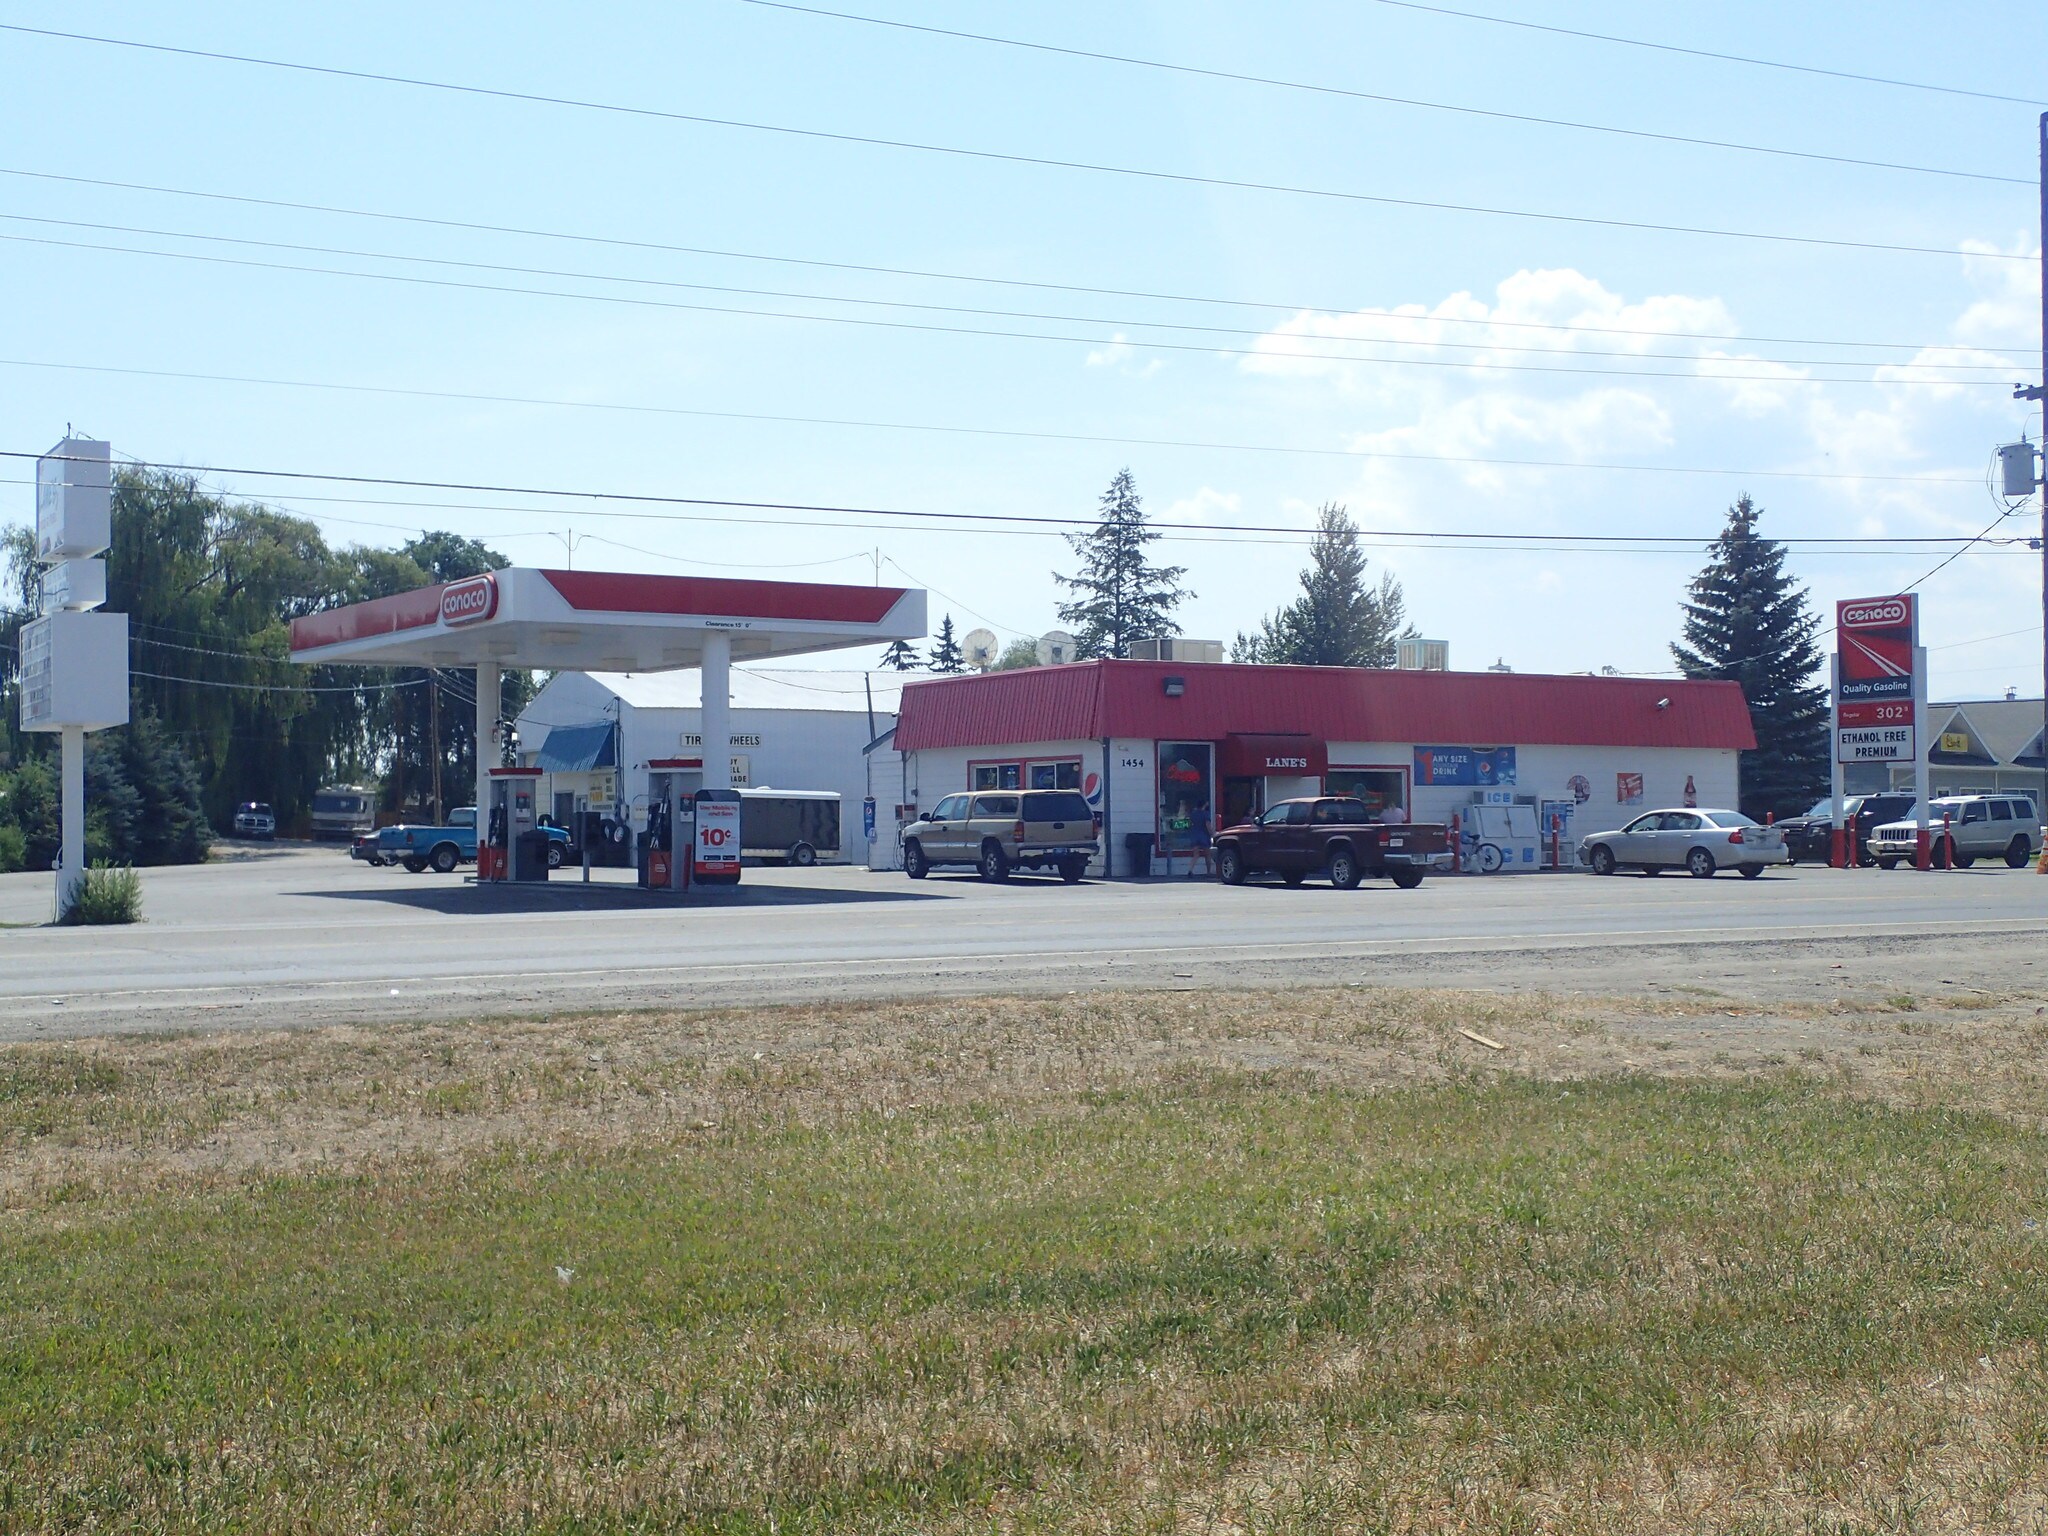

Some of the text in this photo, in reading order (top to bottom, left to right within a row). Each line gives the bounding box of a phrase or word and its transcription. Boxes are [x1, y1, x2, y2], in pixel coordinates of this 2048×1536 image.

[1842, 681, 1908, 695] Quality Gasoline
[1841, 730, 1907, 744] ETHANOL FREE
[1855, 746, 1898, 758] PREMIUM
[1121, 758, 1144, 768] 1454
[1265, 757, 1307, 768] LANE'S
[1432, 755, 1449, 763] ANY
[1450, 755, 1468, 763] SIZE
[1432, 767, 1457, 776] DRINK
[1487, 792, 1511, 803] ICE
[1173, 821, 1189, 829] ATM
